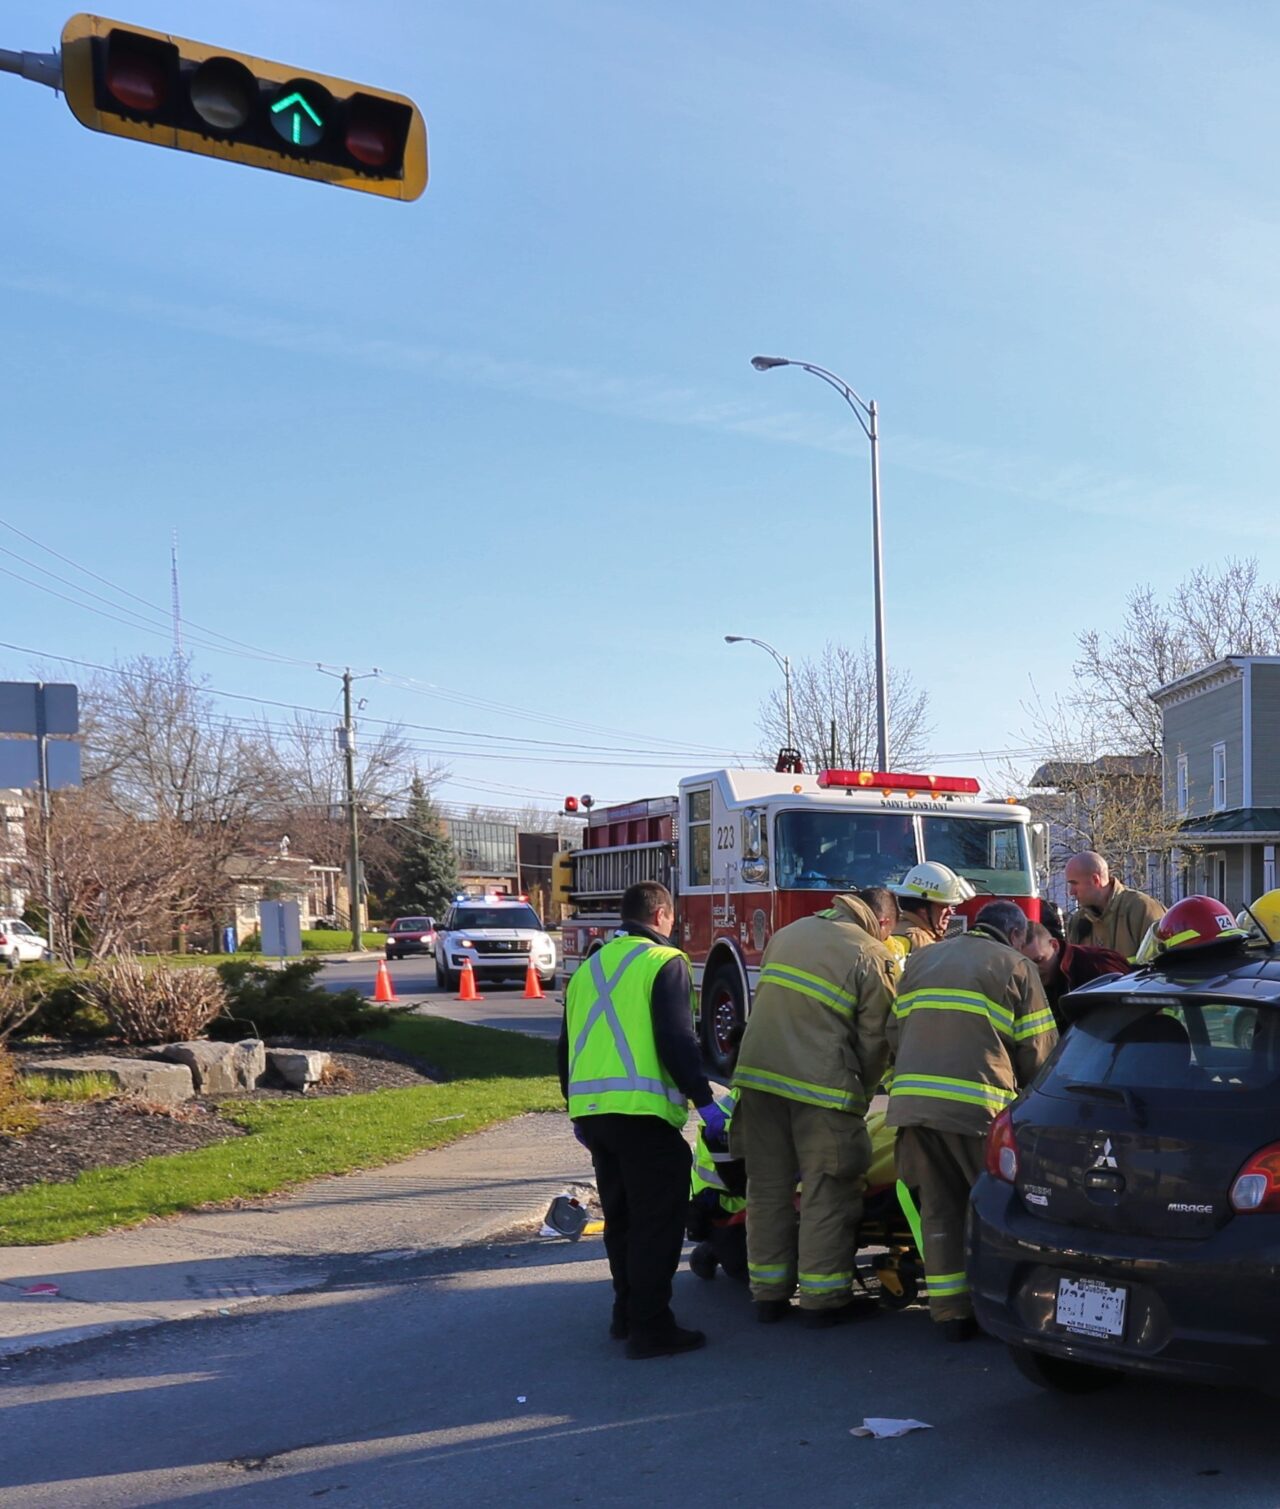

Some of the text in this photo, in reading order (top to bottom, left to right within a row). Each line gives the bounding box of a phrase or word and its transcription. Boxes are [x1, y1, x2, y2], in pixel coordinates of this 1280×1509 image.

[880, 799, 949, 811] SAINT-CONSTANT
[717, 825, 735, 850] 223
[911, 876, 940, 890] 23-114
[1217, 917, 1233, 929] 24
[1167, 1203, 1214, 1214] MIRAGE
